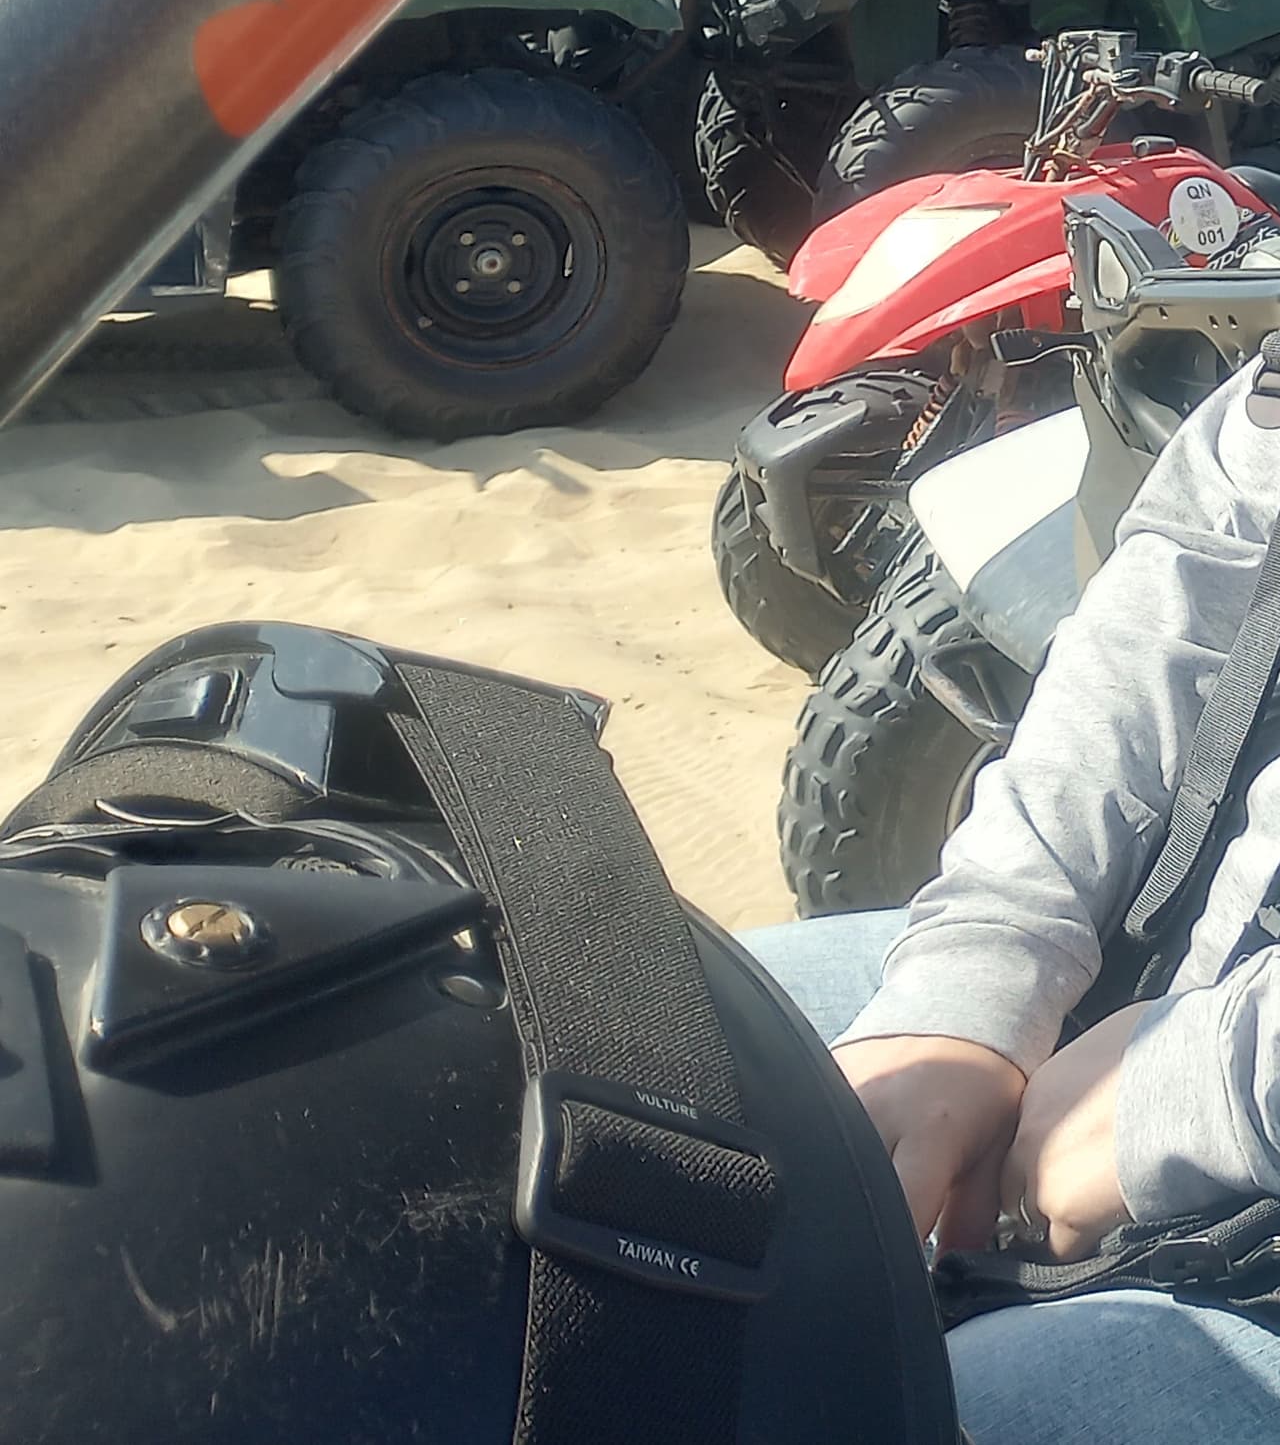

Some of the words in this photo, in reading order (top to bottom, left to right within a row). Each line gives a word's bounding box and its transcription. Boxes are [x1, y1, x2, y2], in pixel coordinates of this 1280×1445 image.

[1187, 184, 1212, 200] QN
[1198, 228, 1225, 246] 001
[634, 1091, 698, 1120] VULTURE
[617, 1238, 676, 1270] TAIWAN
